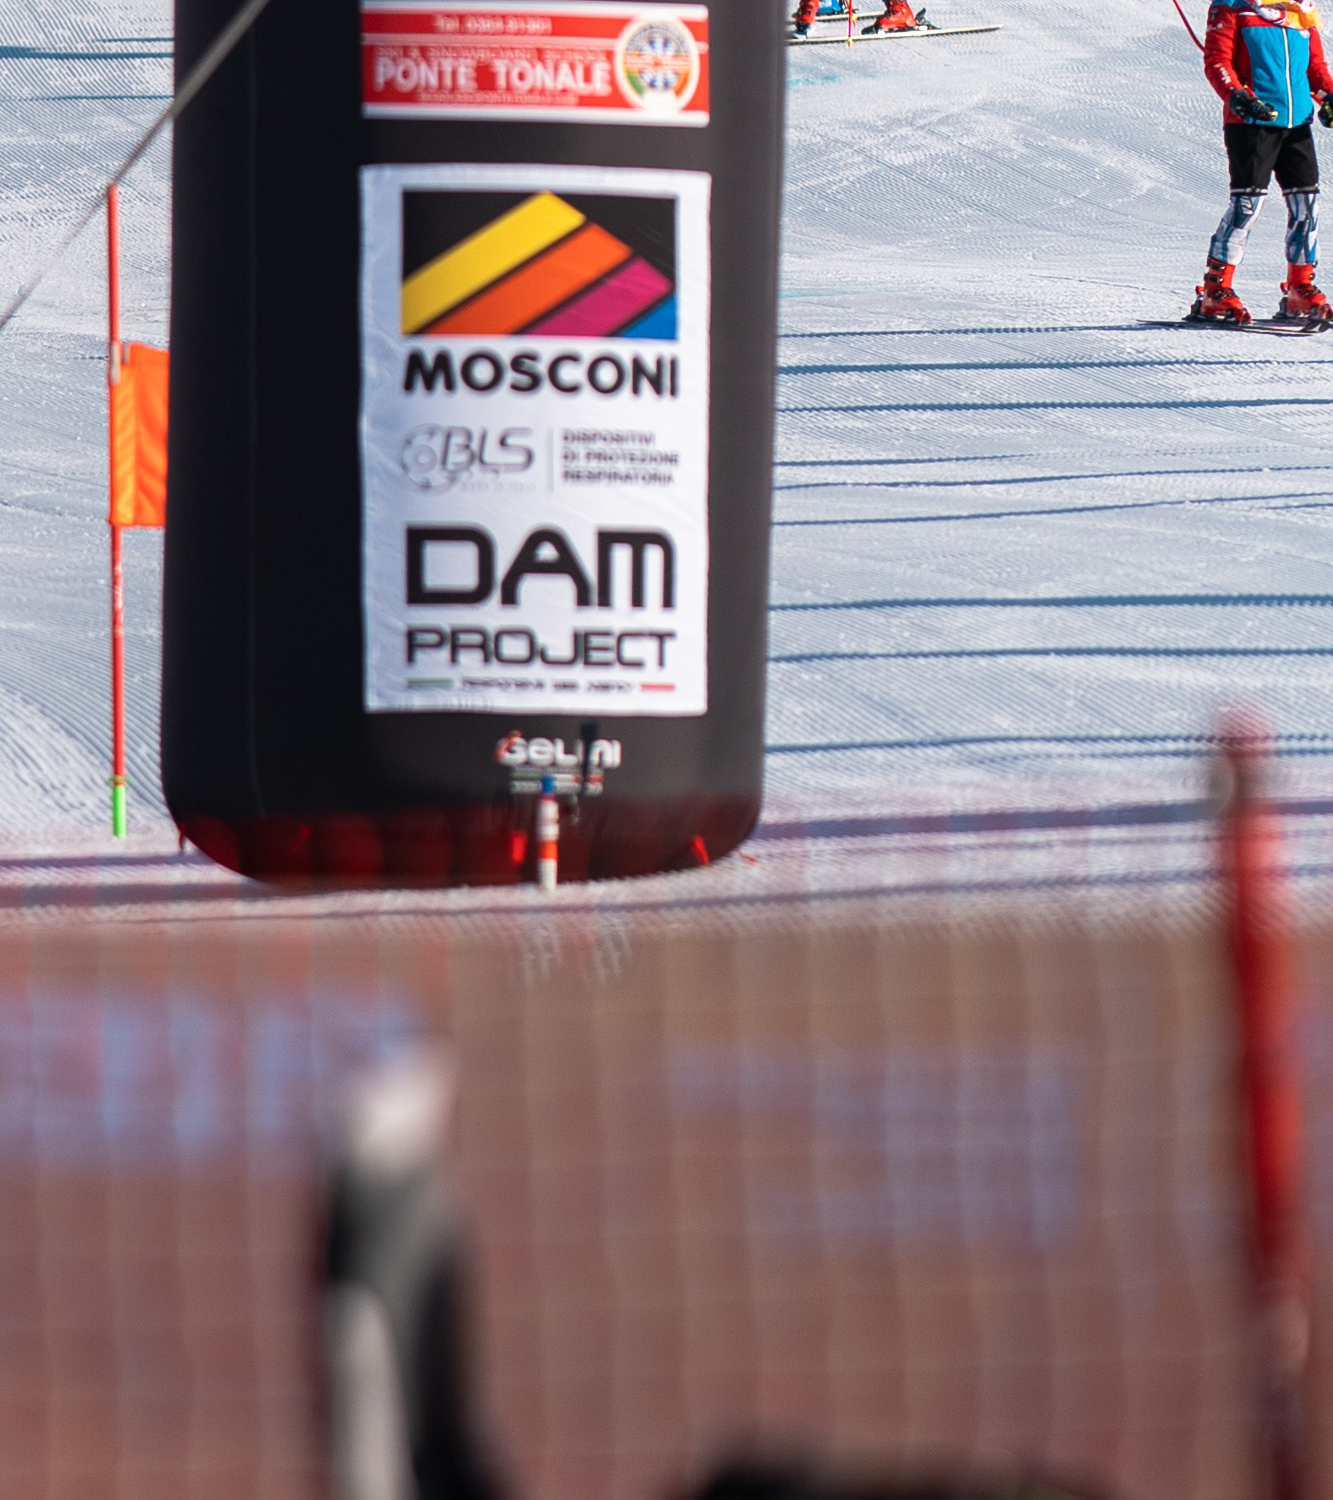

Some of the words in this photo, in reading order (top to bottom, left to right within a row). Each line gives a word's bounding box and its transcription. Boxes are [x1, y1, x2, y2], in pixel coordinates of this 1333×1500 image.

[373, 58, 477, 93] PONTE
[490, 60, 612, 97] TONALE
[403, 350, 680, 398] MOSCONI
[406, 526, 676, 609] DAM
[405, 626, 677, 669] PROJECT
